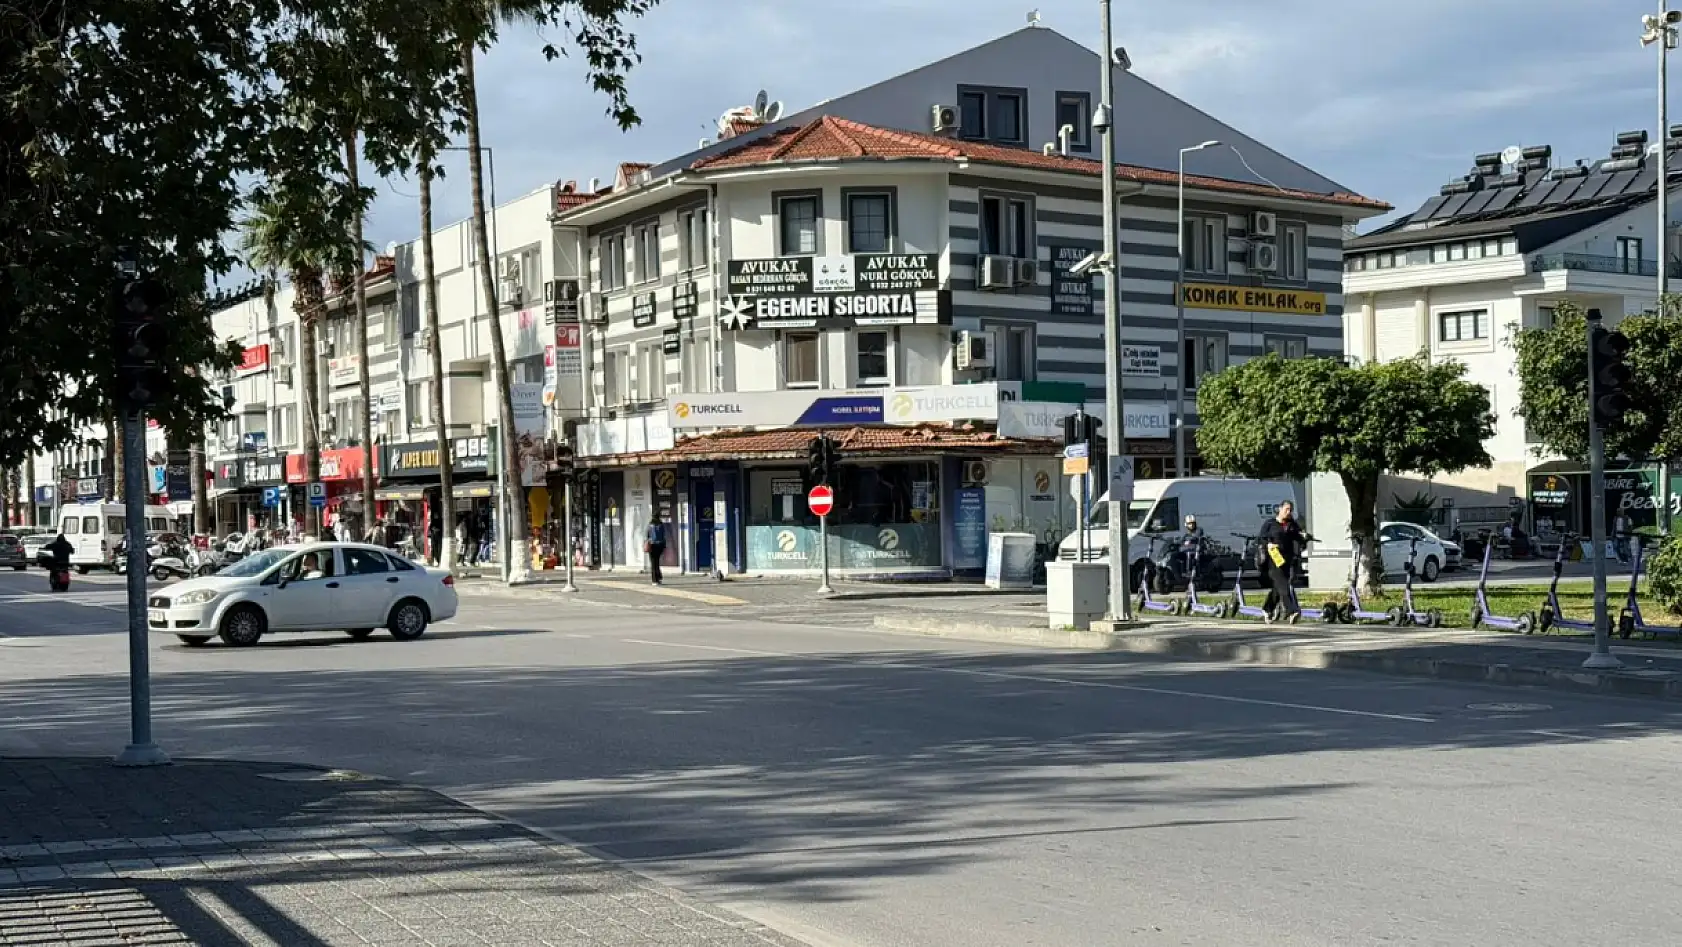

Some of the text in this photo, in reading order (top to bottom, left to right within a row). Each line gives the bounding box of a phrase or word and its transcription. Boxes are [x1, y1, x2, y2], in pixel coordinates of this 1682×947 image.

[741, 261, 799, 273] AVUKAT
[866, 256, 928, 269] AVUKAT
[860, 268, 936, 282] NURİ GÖKÇÖL
[1183, 286, 1239, 306] KONAK
[756, 296, 830, 318] EGEMEN
[691, 403, 743, 414] TURKCELL
[916, 394, 993, 411] TURKCELL
[1123, 413, 1169, 429] URKCELL
[264, 489, 276, 504] P
[767, 551, 808, 560] TURKCELL
[867, 550, 912, 559] TURKCELL
